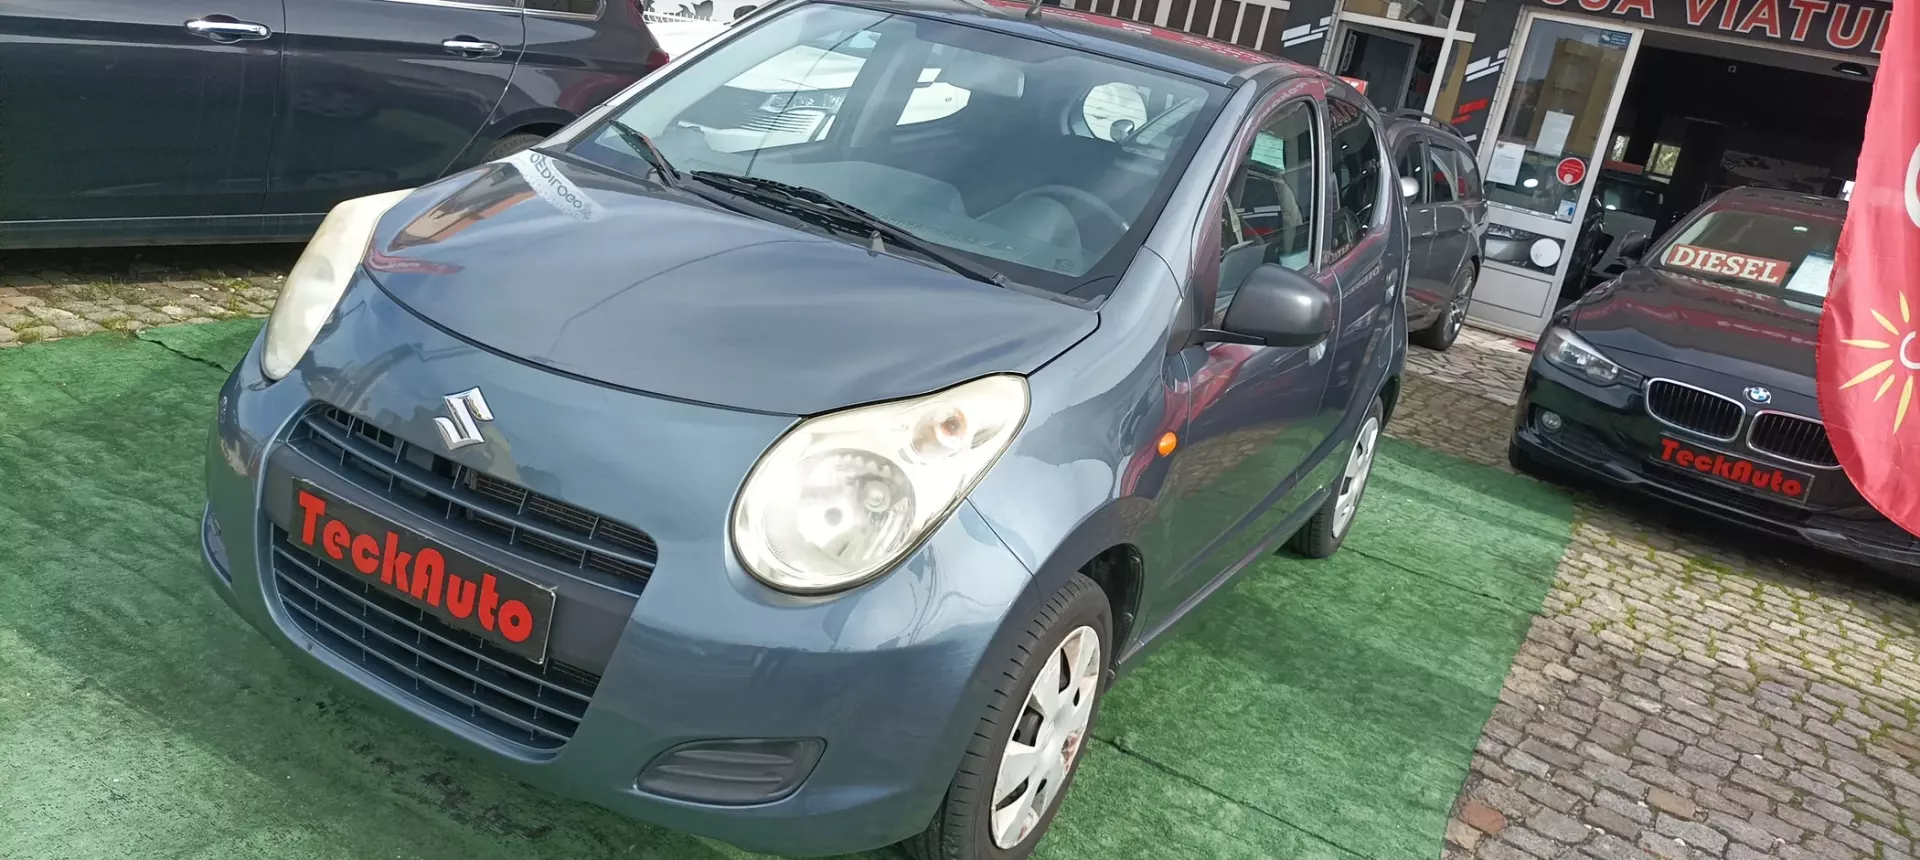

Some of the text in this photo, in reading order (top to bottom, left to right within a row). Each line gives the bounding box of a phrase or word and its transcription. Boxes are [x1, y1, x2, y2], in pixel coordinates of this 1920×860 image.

[1671, 246, 1779, 284] DIESEL
[1661, 438, 1803, 496] TeckAuto
[299, 490, 533, 643] TeckAuto
